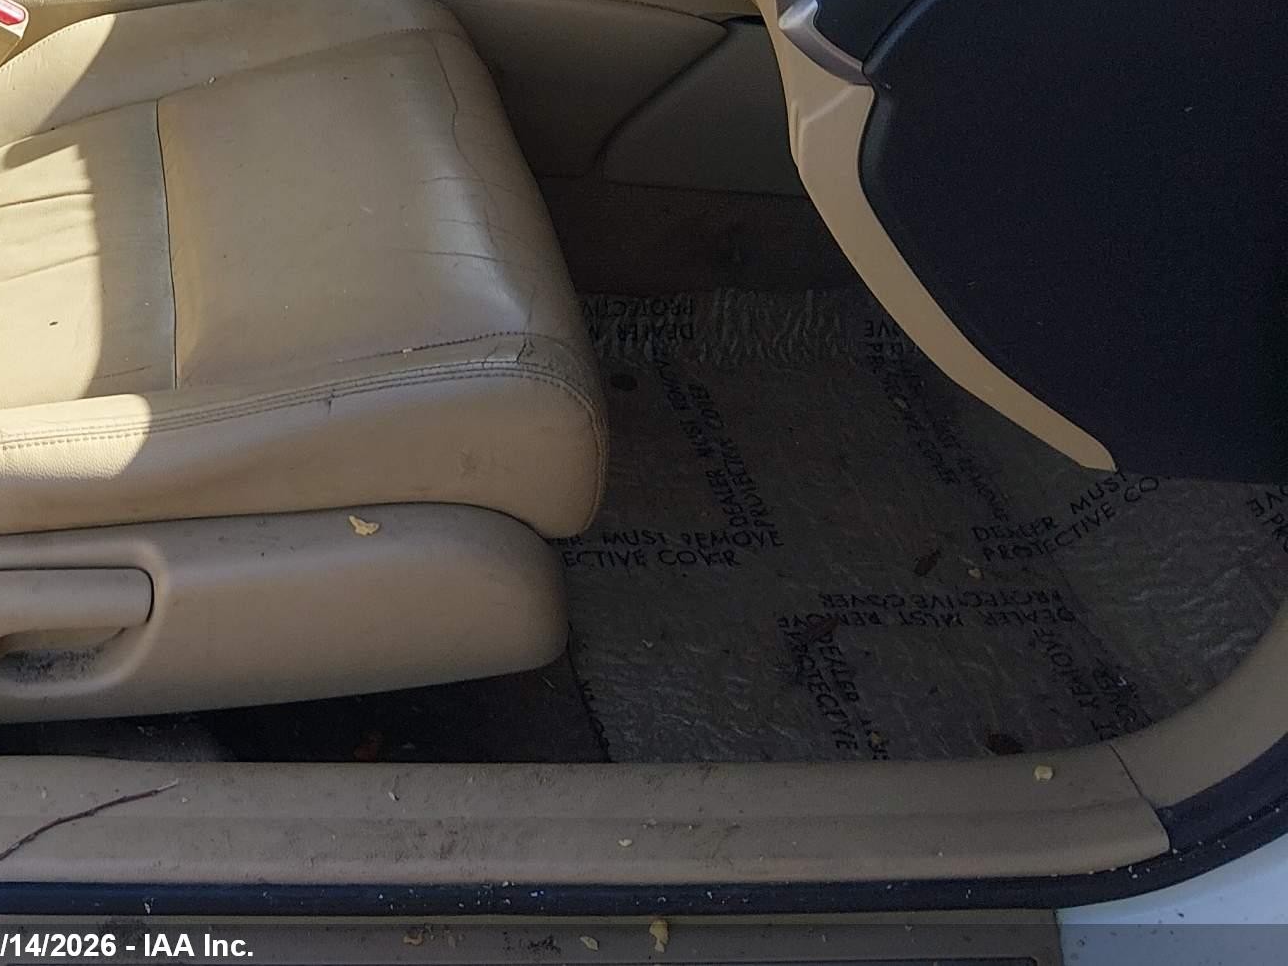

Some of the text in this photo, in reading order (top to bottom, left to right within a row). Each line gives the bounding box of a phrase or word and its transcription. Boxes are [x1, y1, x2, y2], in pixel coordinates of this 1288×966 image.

[601, 529, 668, 546] MUST
[680, 530, 785, 548] REMOVE
[982, 502, 1117, 562] PROTECTIVE
[562, 550, 742, 568] ECTIVE COVER
